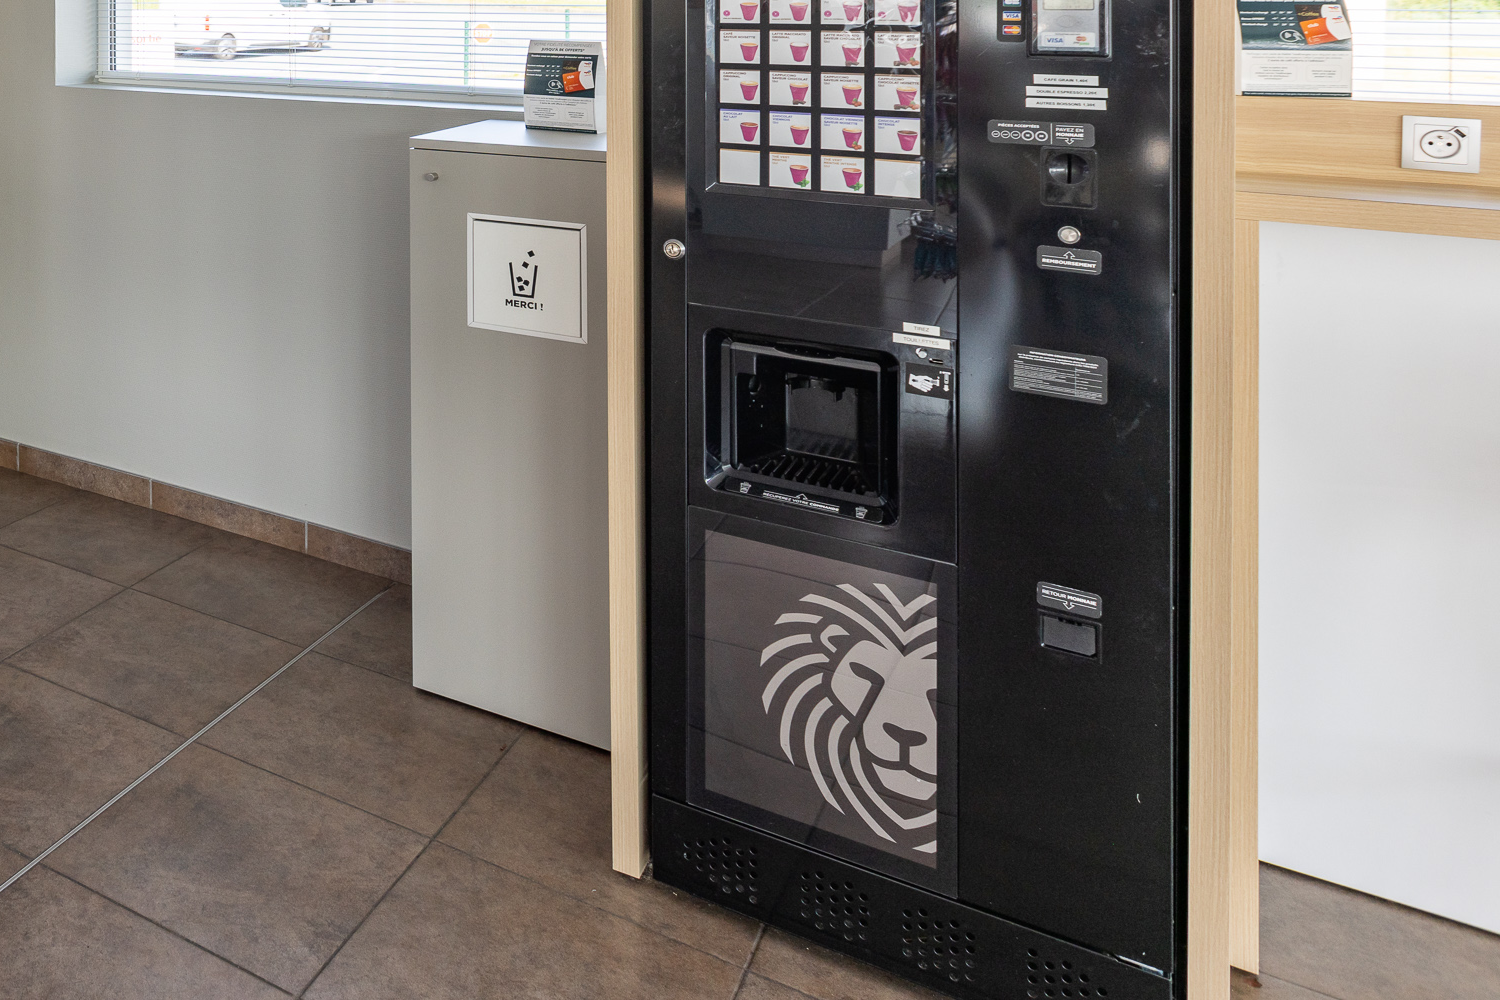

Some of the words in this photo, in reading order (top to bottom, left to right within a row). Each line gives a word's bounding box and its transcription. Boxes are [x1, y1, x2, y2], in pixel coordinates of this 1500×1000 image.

[1041, 258, 1097, 269] REMBOURSEMENT
[505, 298, 537, 311] MERCI
[1041, 588, 1067, 599] RETOUR
[1067, 595, 1097, 607] MONNAIE
